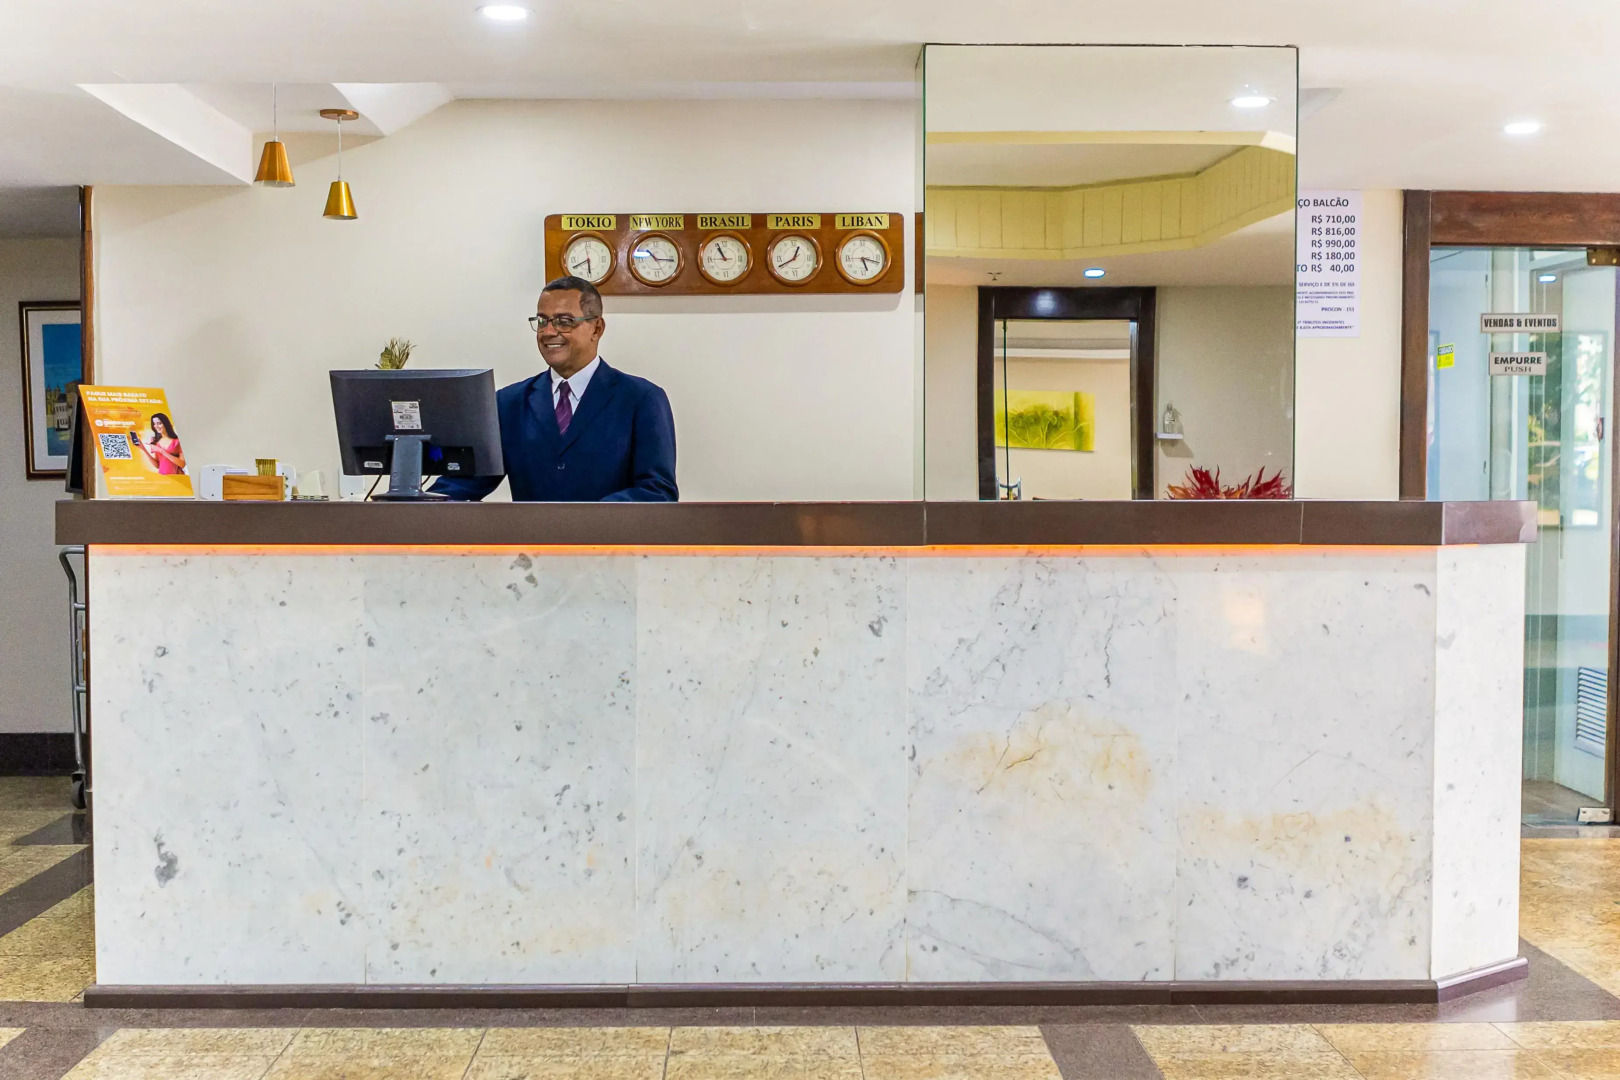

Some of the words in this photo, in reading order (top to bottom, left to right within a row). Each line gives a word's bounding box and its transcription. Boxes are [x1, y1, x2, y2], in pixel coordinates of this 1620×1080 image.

[1298, 199, 1310, 209] ÇO
[1313, 197, 1349, 207] BALCÃO
[567, 217, 611, 228] TOKIO
[632, 216, 652, 228] NEW
[655, 216, 682, 228] YORK
[700, 216, 749, 227] BRASIL
[775, 216, 814, 227] PARIS
[842, 216, 883, 227] LIBAN
[1311, 215, 1322, 224] R$
[1326, 215, 1356, 224] 710,00
[1311, 227, 1322, 236] R$
[1326, 227, 1356, 236] 816,00
[1311, 239, 1322, 248] R$
[1326, 240, 1356, 249] 990,00
[1311, 251, 1322, 261] R$
[1326, 252, 1356, 261] 180,00
[1311, 264, 1322, 273] R$
[1330, 264, 1355, 273] 40,00
[1484, 319, 1514, 327] VENDAS
[1517, 319, 1522, 327] &
[1525, 319, 1557, 327] EVENTOS
